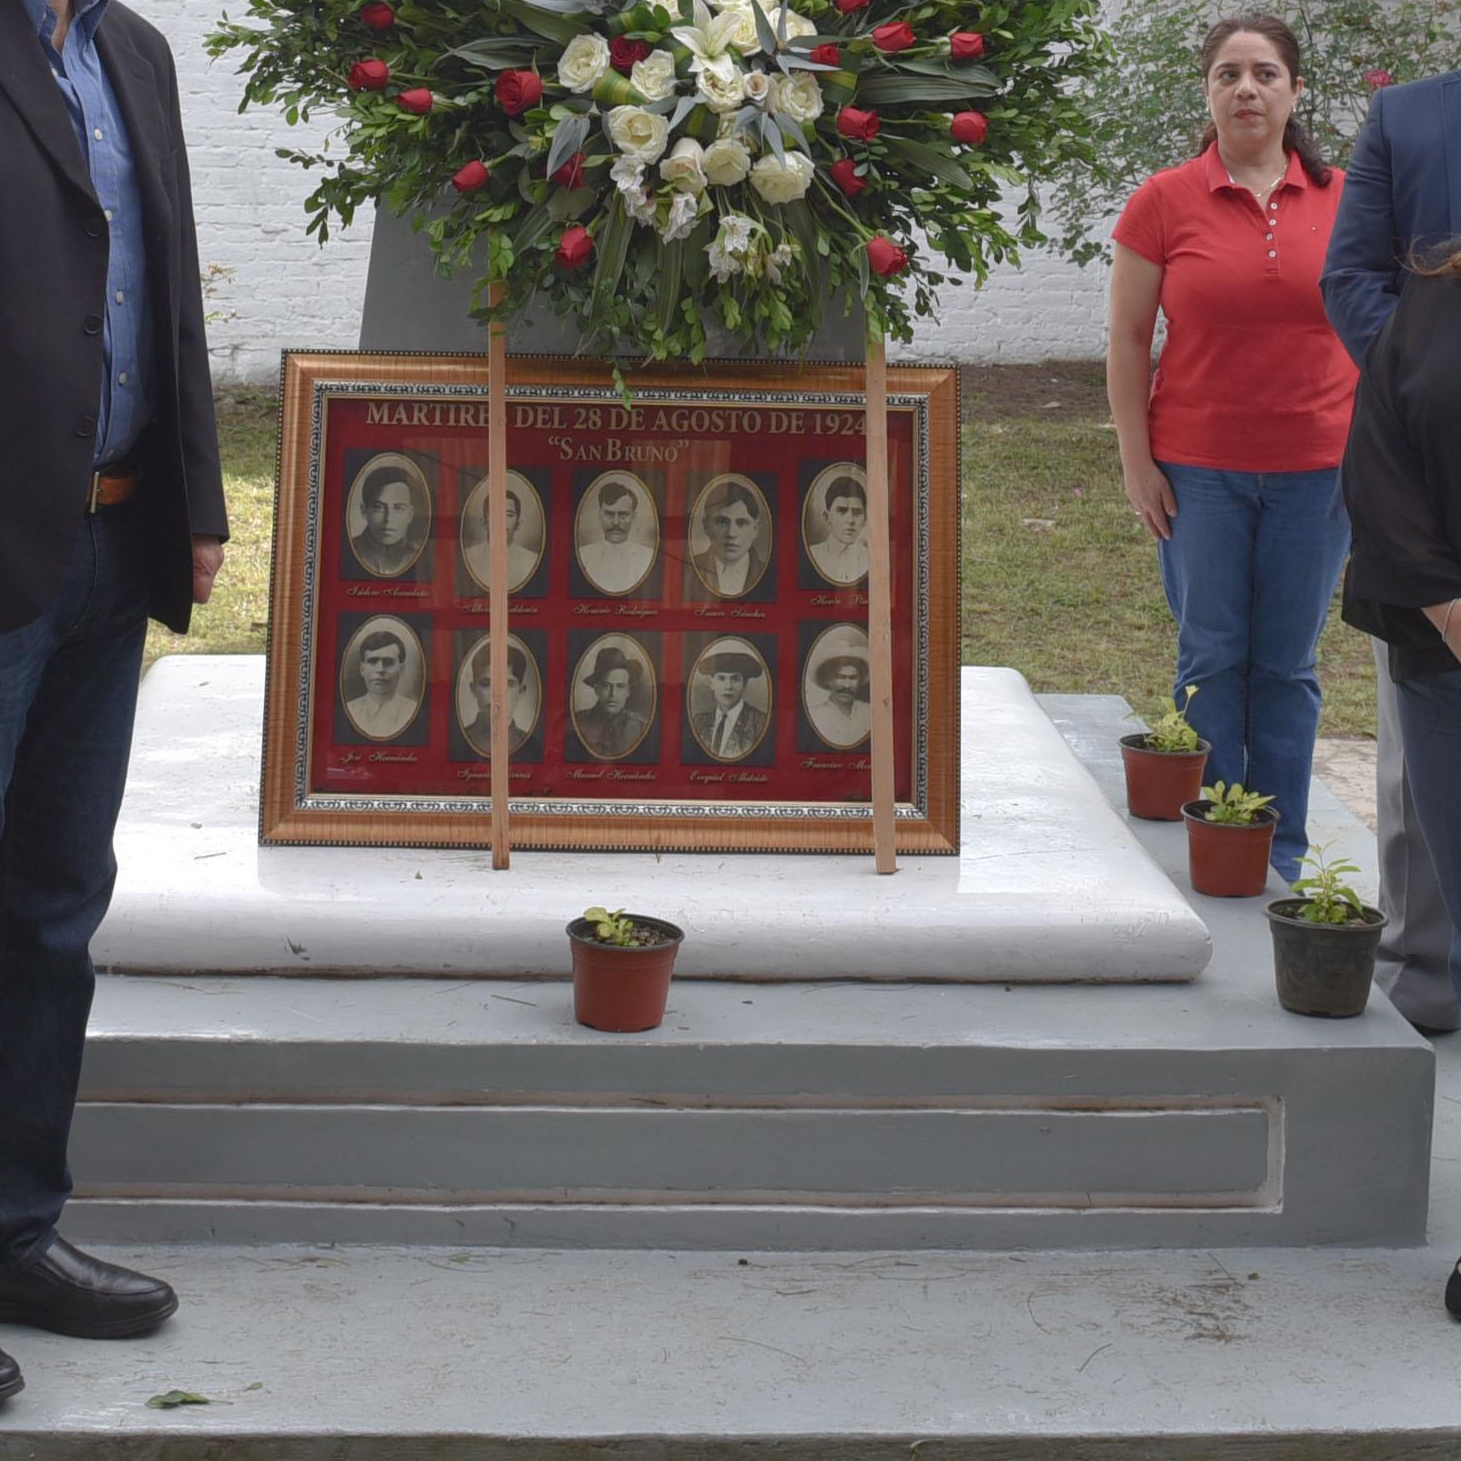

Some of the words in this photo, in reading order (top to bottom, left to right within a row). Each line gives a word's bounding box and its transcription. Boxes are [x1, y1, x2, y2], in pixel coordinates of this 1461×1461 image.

[365, 401, 506, 427] MARTIRE
[515, 405, 567, 429] DEL
[573, 407, 602, 430] 28
[609, 408, 645, 431] DE
[651, 409, 762, 434] AGOSTO
[768, 411, 805, 435] DE
[812, 413, 867, 436] 1924
